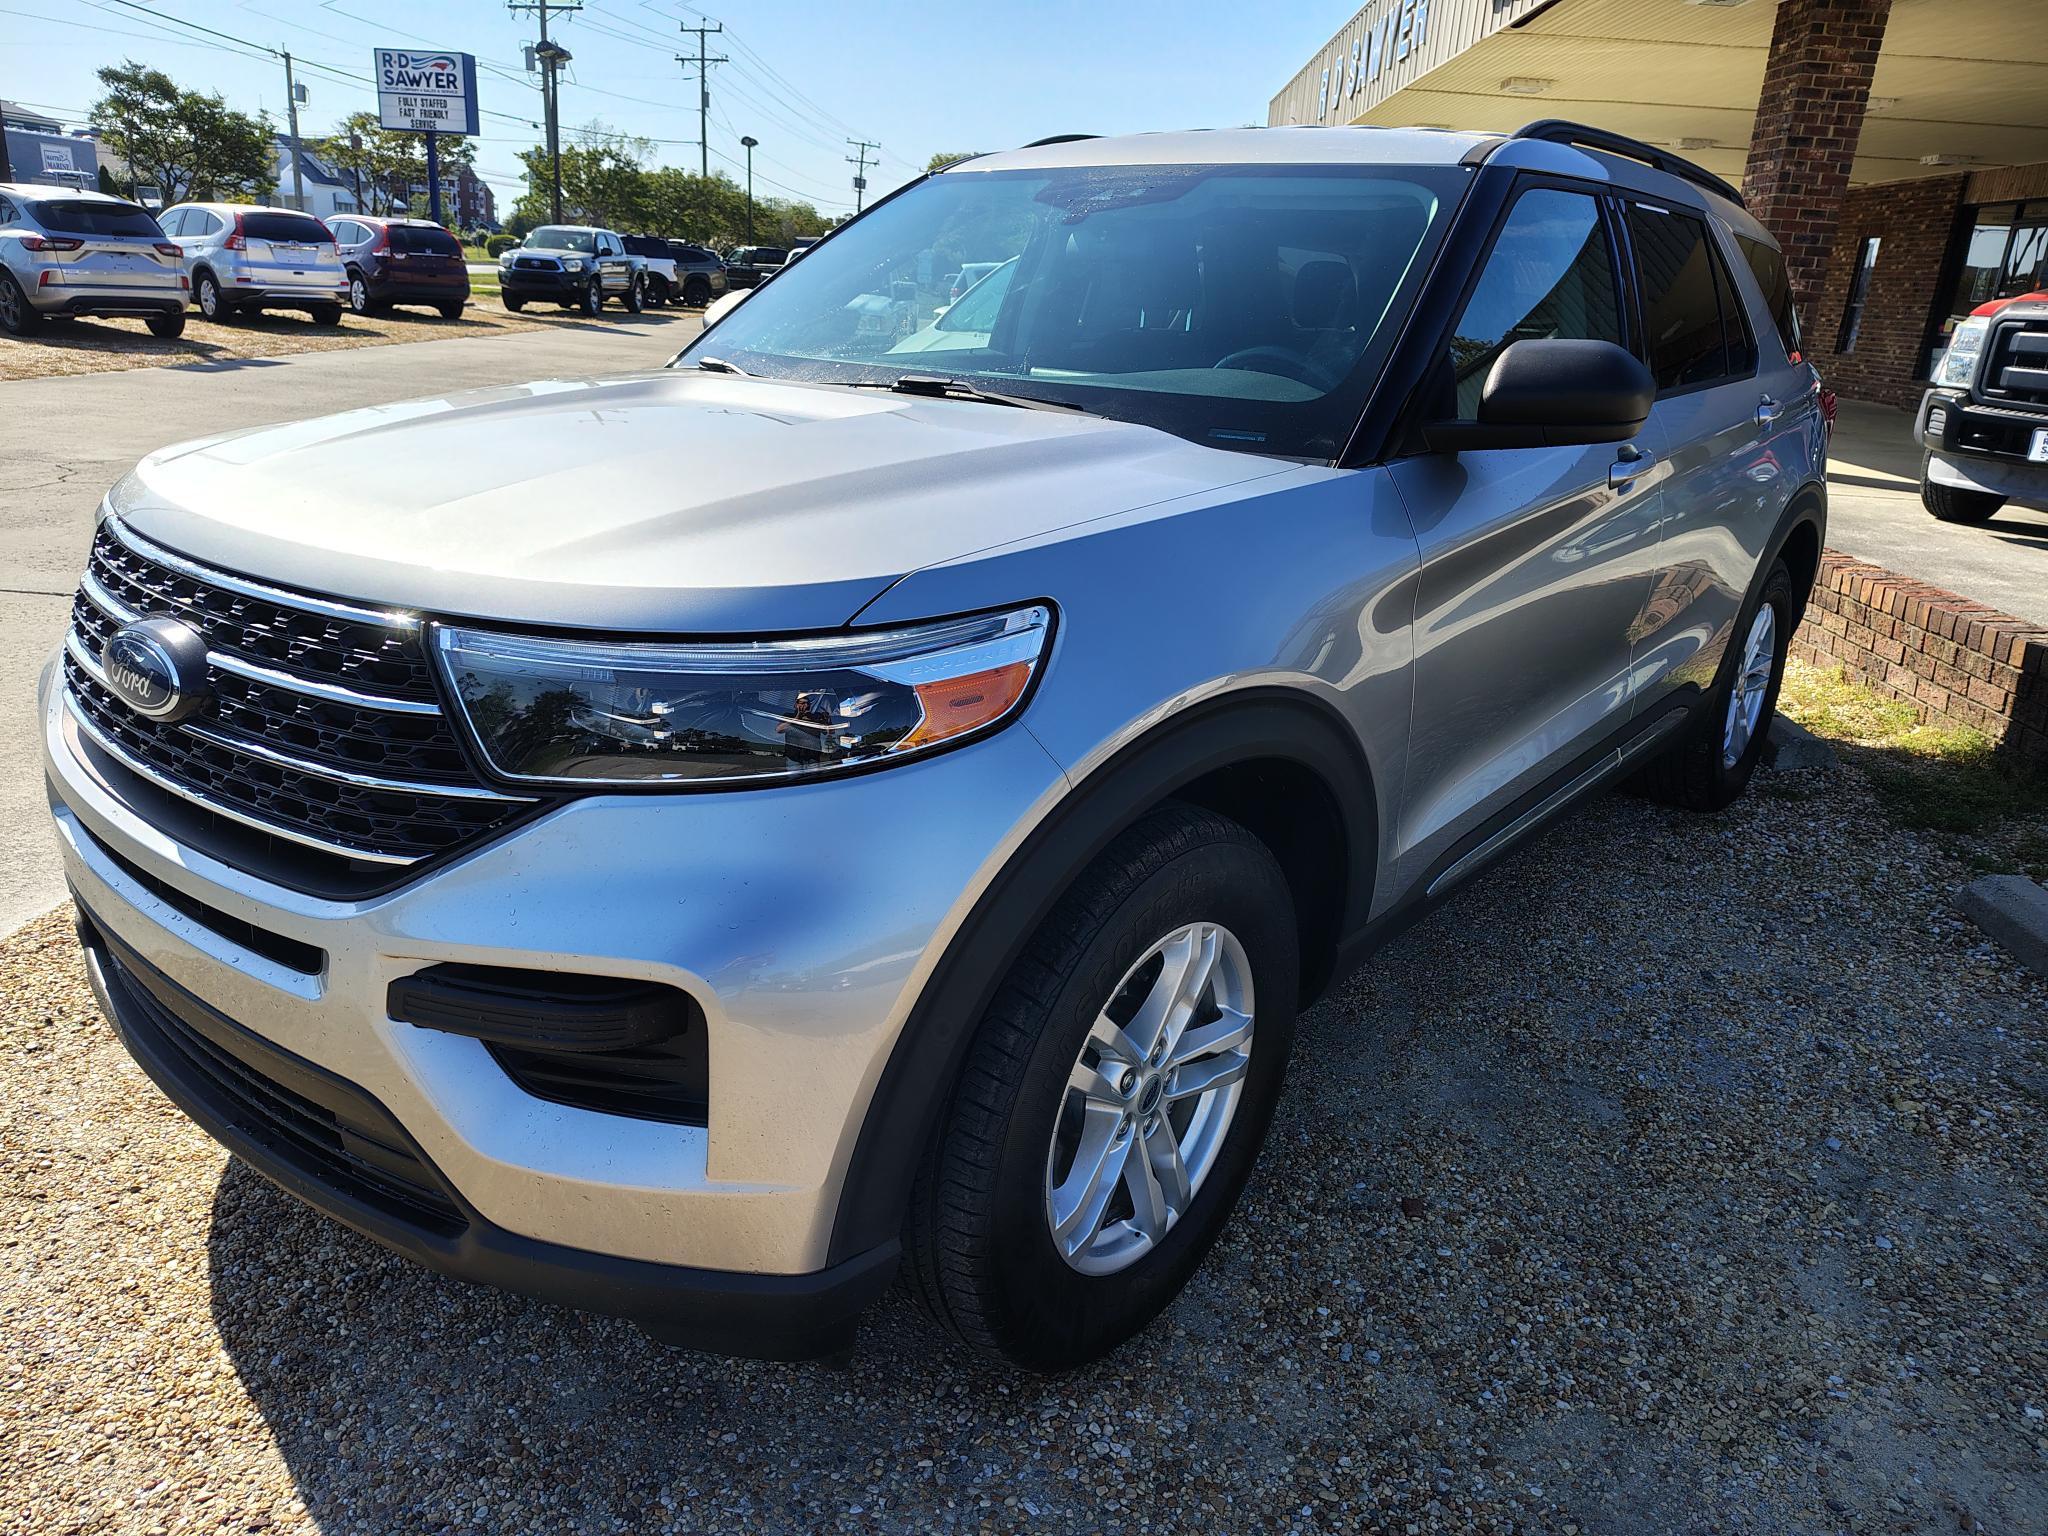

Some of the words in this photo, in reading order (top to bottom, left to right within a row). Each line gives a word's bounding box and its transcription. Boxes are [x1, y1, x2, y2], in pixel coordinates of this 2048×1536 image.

[1345, 0, 1430, 100] SAWYER
[383, 69, 459, 90] SAWYER
[398, 96, 418, 107] FULLY
[420, 98, 448, 109] STAFFED
[399, 108, 415, 118] FAST
[420, 109, 449, 120] FRIENDLY
[410, 119, 437, 130] SERVICE
[909, 646, 1024, 677] EXPLORER
